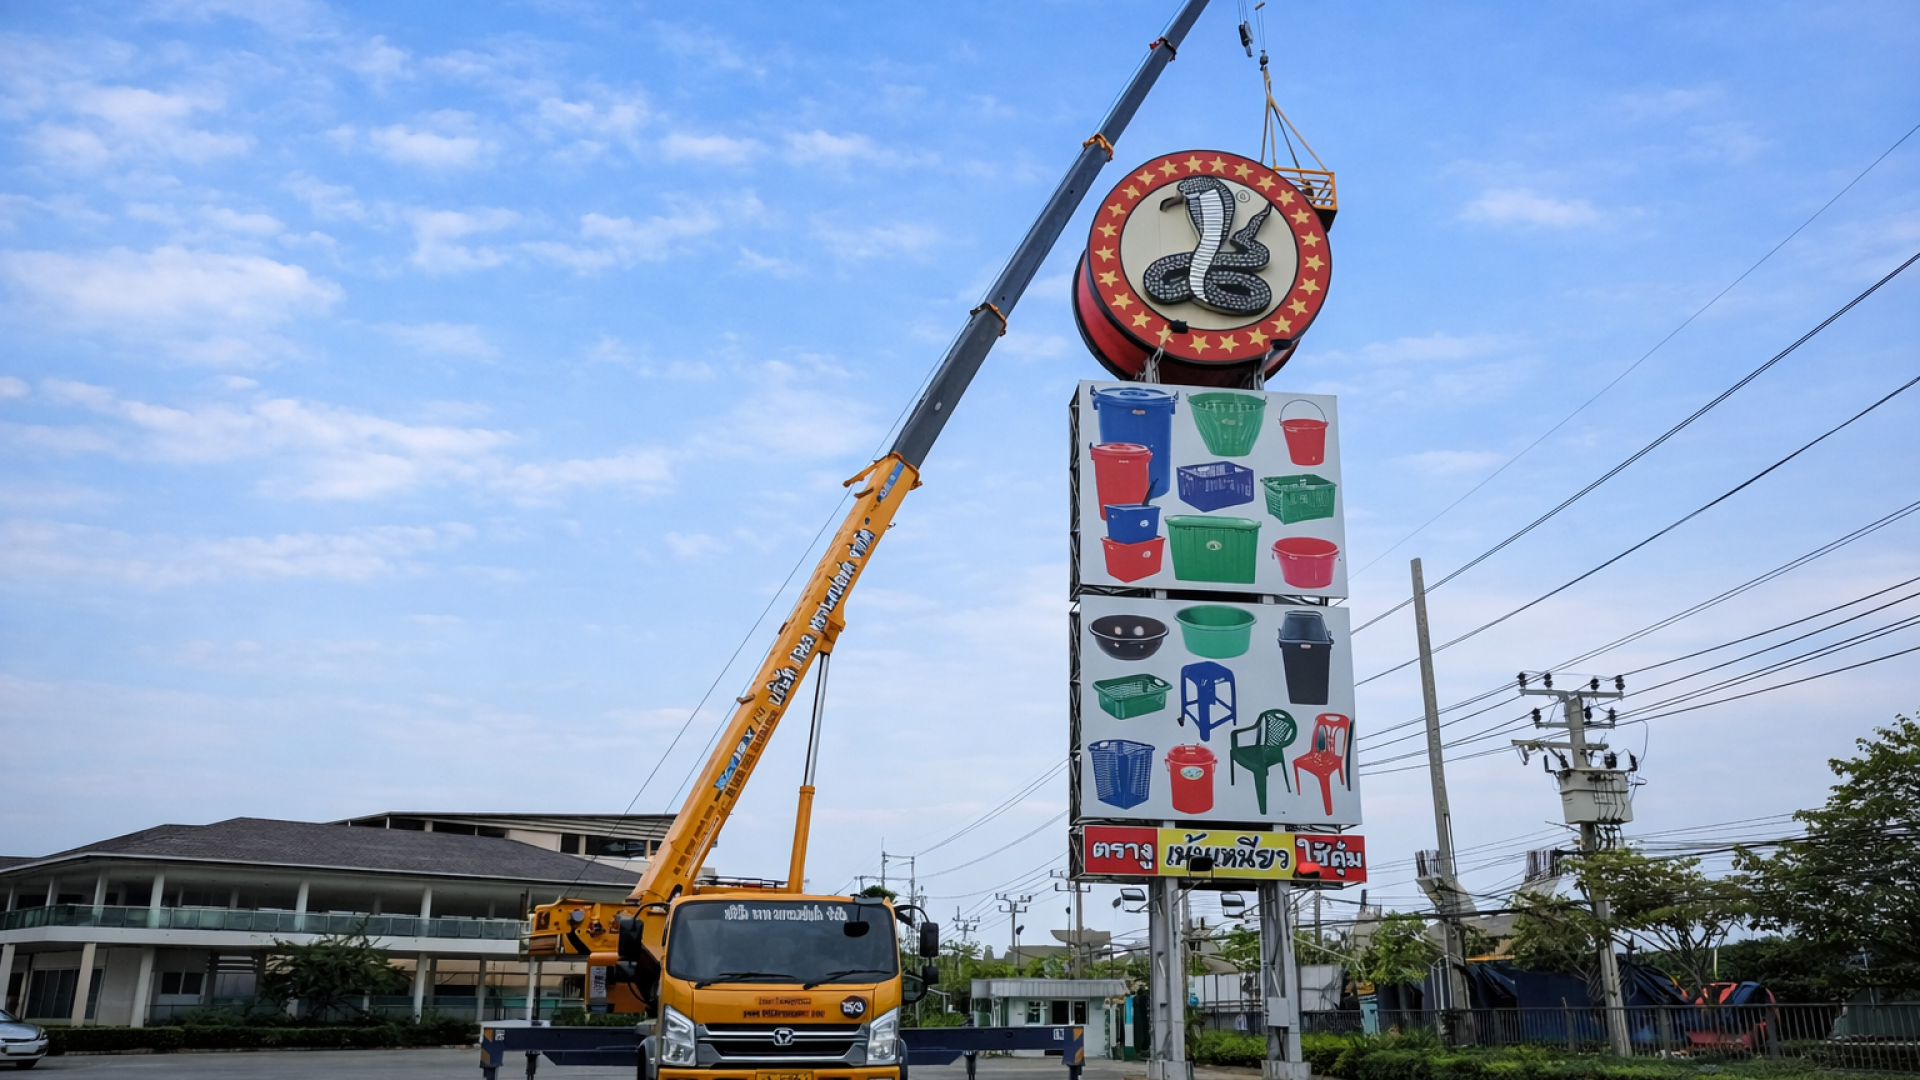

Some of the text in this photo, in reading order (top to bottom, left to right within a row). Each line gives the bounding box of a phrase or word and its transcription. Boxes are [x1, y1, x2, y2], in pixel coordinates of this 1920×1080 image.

[1093, 840, 1154, 869] ตรางู
[1296, 838, 1362, 876] ใช้คุ้ม
